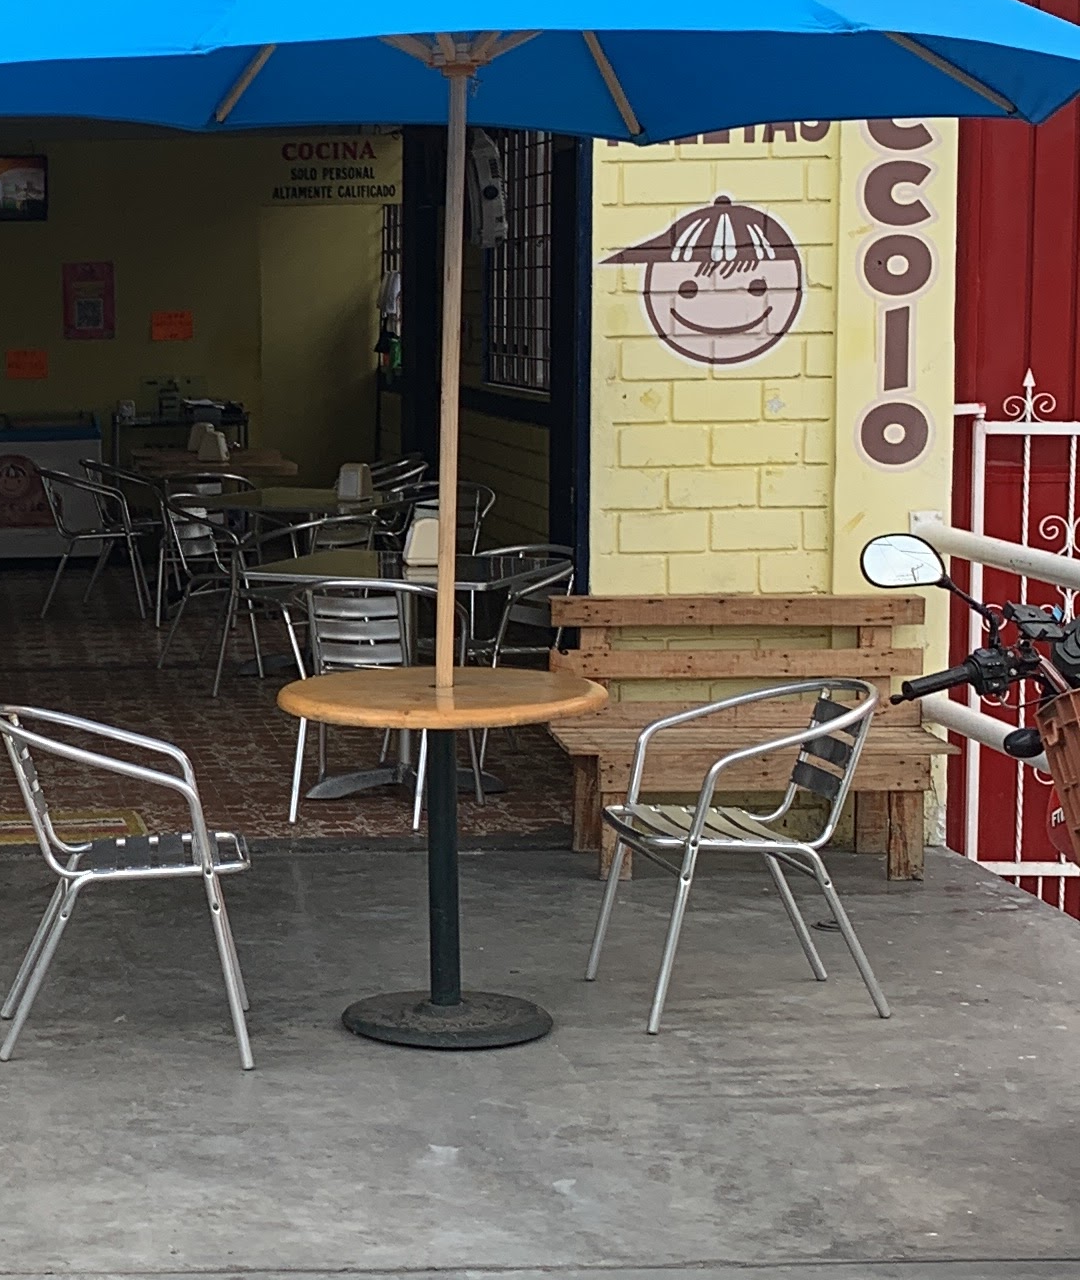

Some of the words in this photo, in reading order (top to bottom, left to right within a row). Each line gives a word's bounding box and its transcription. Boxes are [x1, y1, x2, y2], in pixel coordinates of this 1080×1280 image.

[281, 139, 377, 161] COCINA
[290, 167, 317, 181] SOLO
[322, 166, 375, 181] PERSONAL
[272, 185, 333, 200] ALTAMENTE
[337, 184, 396, 199] CALIFICADO
